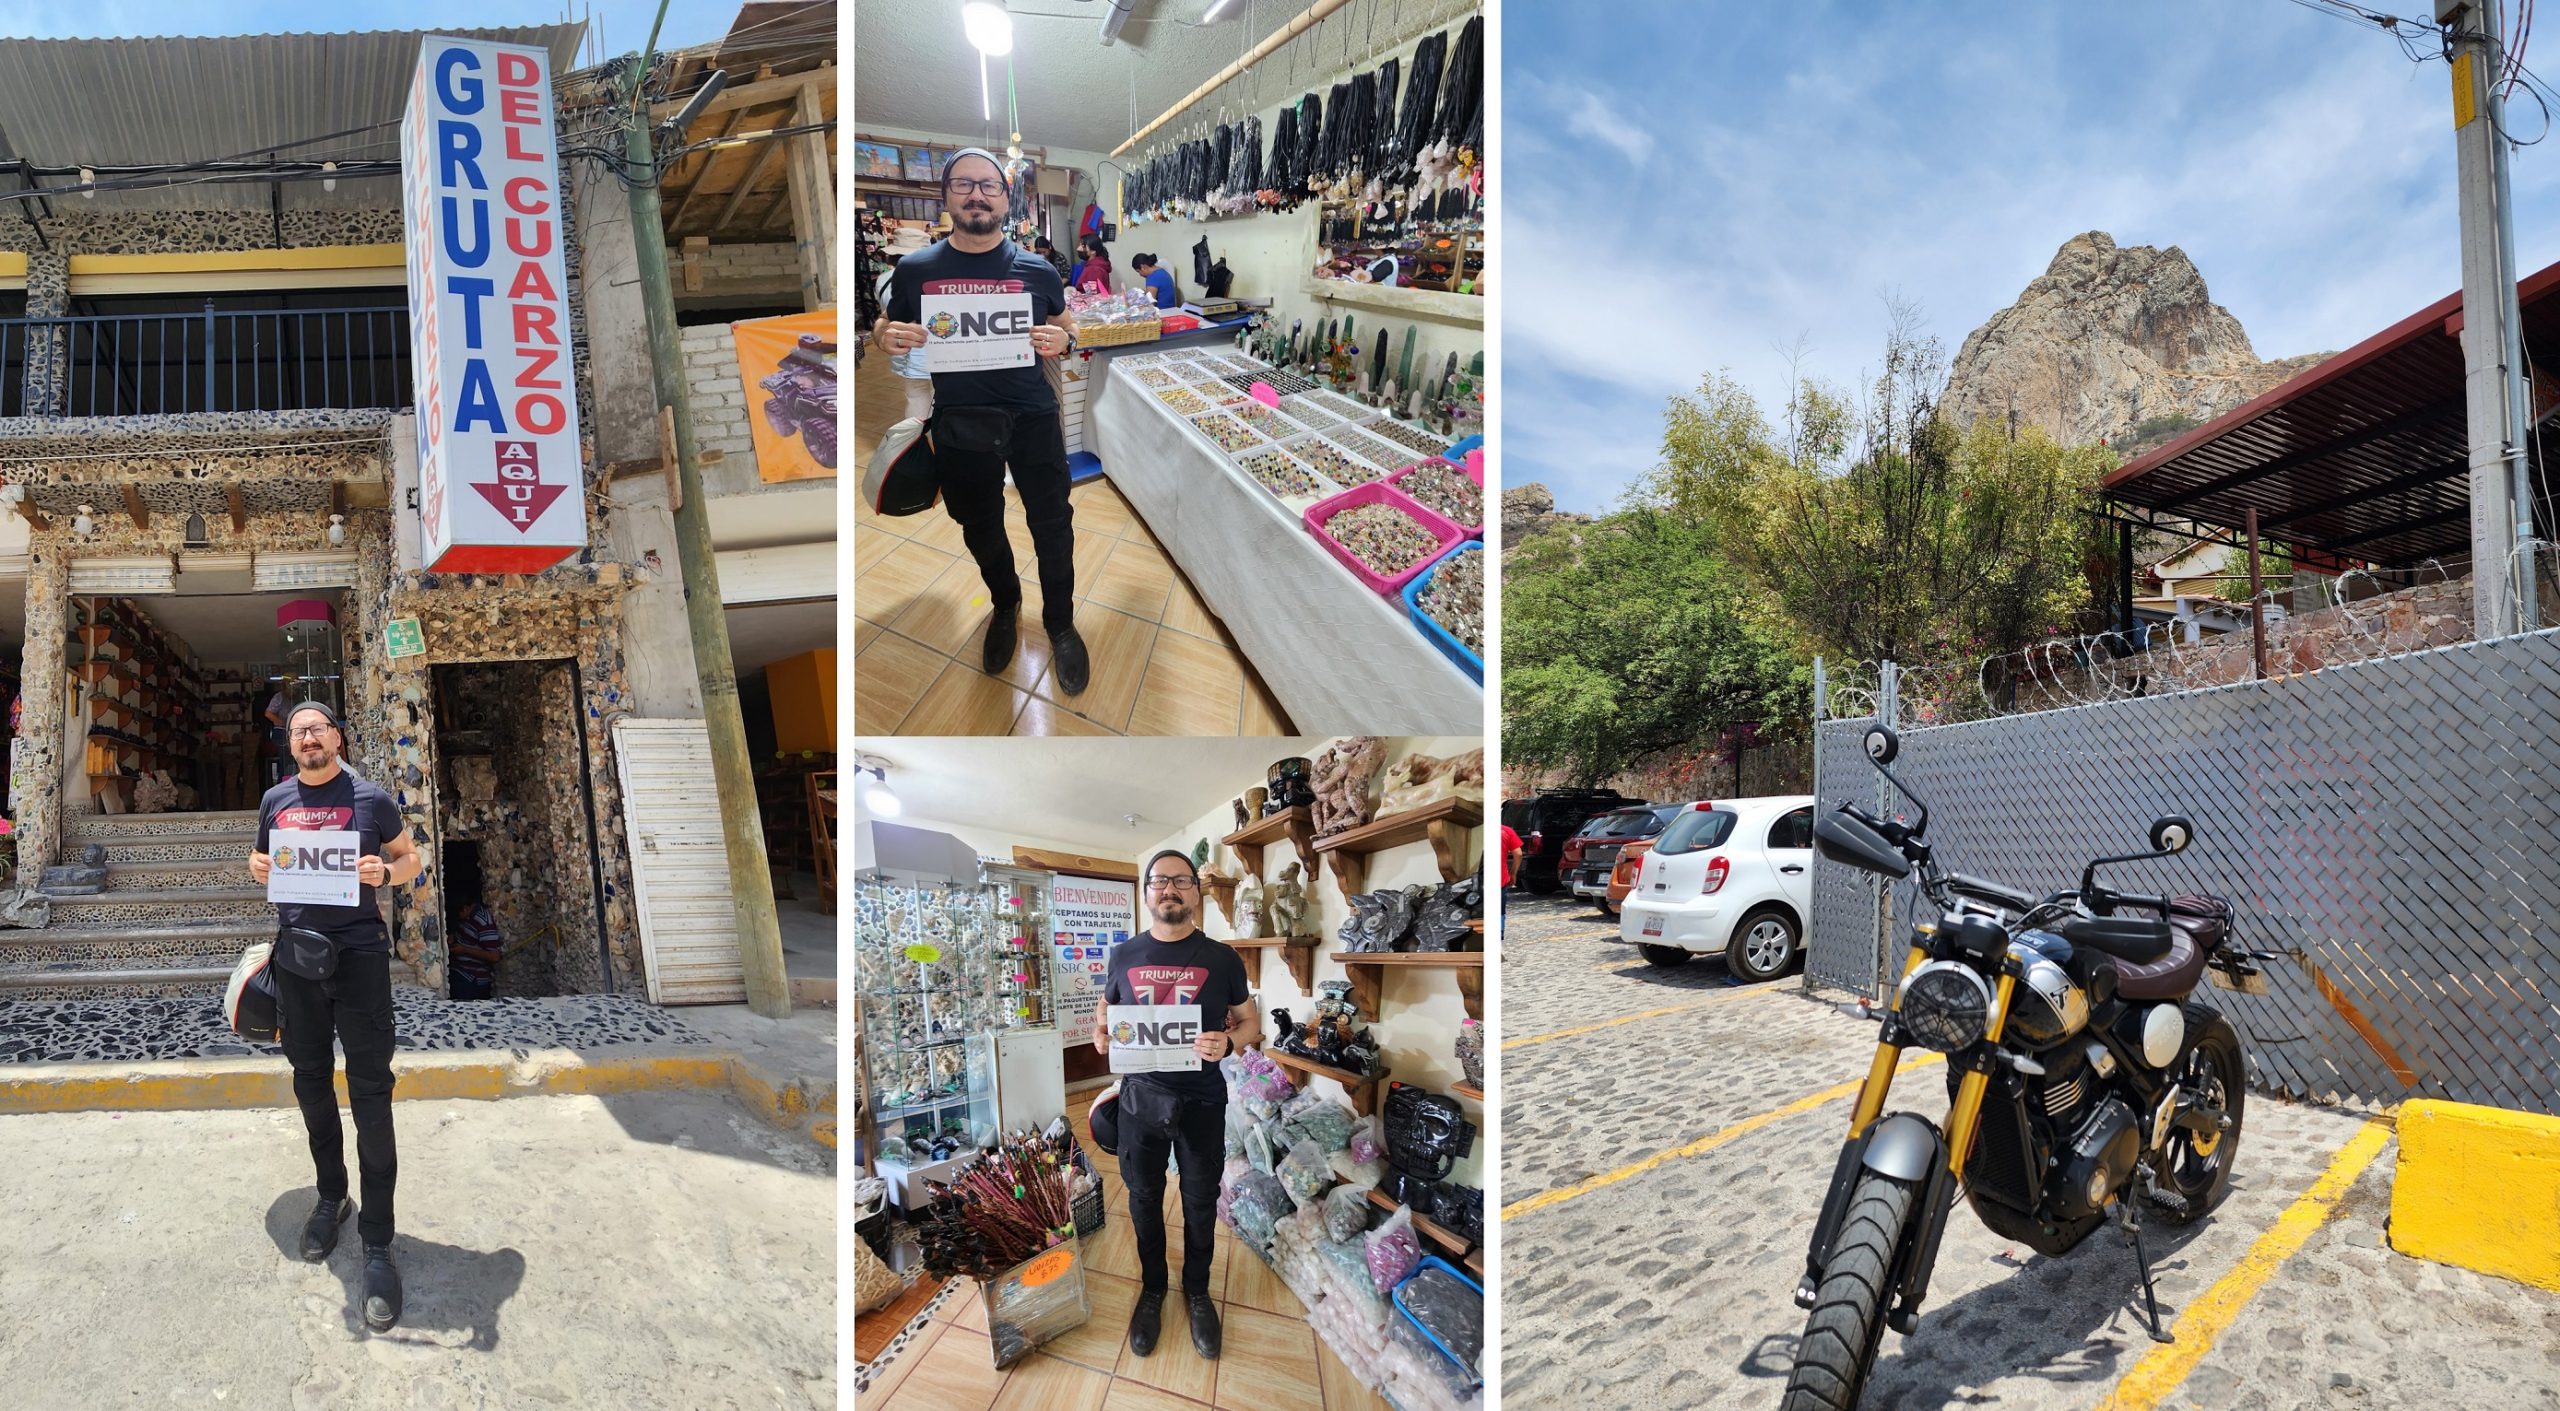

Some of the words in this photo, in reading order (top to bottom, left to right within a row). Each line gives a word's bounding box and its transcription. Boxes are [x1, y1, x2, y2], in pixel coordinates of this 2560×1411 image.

[496, 52, 544, 162] DEL
[435, 47, 508, 434] GRUTA
[405, 105, 430, 471] GRUTA
[503, 176, 567, 435] CUARZO
[500, 442, 537, 523] AQUI
[1054, 886, 1128, 907] BIENVENIDOS
[1054, 908, 1099, 918] CEPTAMOS
[1100, 911, 1111, 919] SU
[1112, 912, 1132, 920] PAGO
[1064, 919, 1082, 927] CON
[1083, 920, 1122, 928] TARJETAS
[1138, 969, 1195, 984] TRIUMPH
